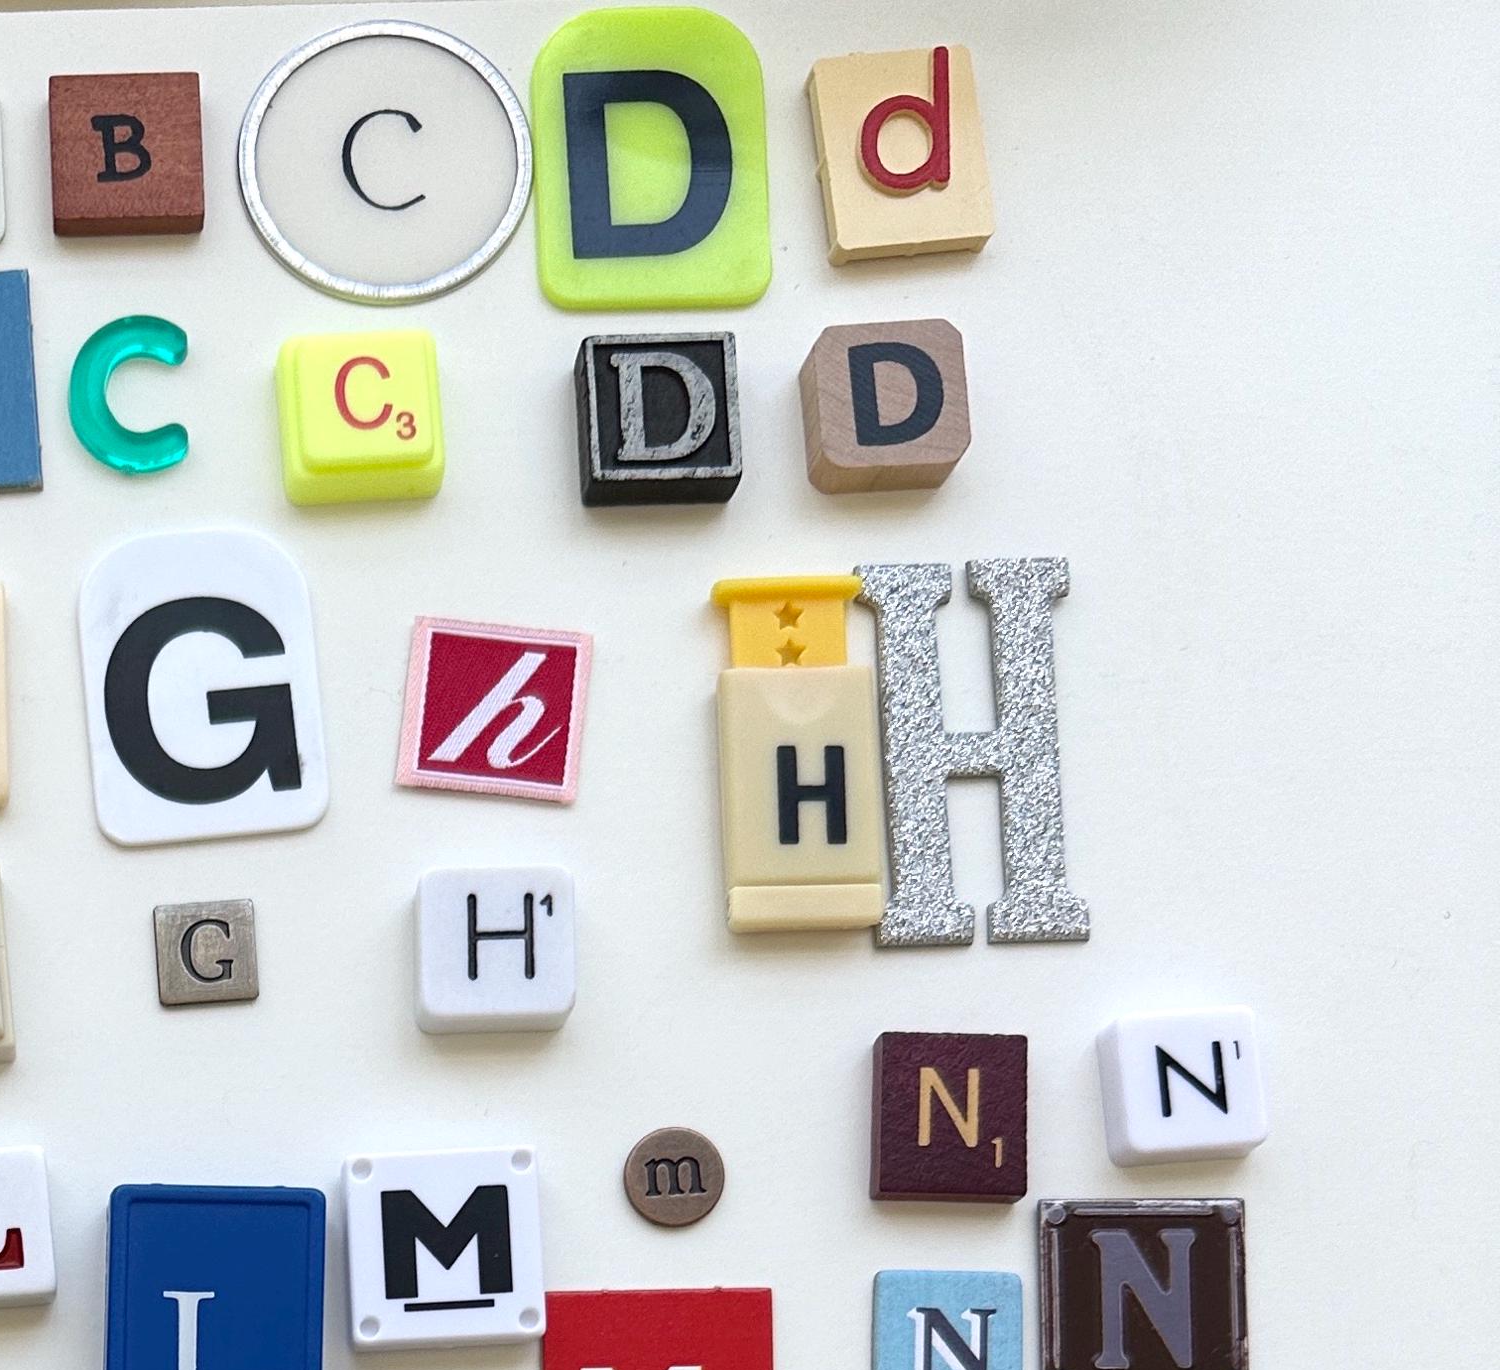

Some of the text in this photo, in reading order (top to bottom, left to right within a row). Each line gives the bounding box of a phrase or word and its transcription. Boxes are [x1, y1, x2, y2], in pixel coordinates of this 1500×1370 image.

[91, 114, 152, 183] B
[342, 108, 426, 211] C
[562, 69, 733, 260] D
[859, 45, 951, 196] d
[68, 313, 190, 475] C
[333, 356, 394, 431] C
[608, 351, 717, 464] D
[847, 342, 944, 447] D
[103, 595, 302, 806] G
[426, 651, 562, 770] h
[852, 557, 1091, 948] H
[776, 744, 849, 846] H
[179, 918, 234, 983] G
[466, 892, 535, 982] H
[917, 1067, 981, 1148] N
[1155, 1040, 1230, 1118] N
[644, 1157, 707, 1198] m
[380, 1184, 514, 1299] M
[1091, 1227, 1196, 1370] N
